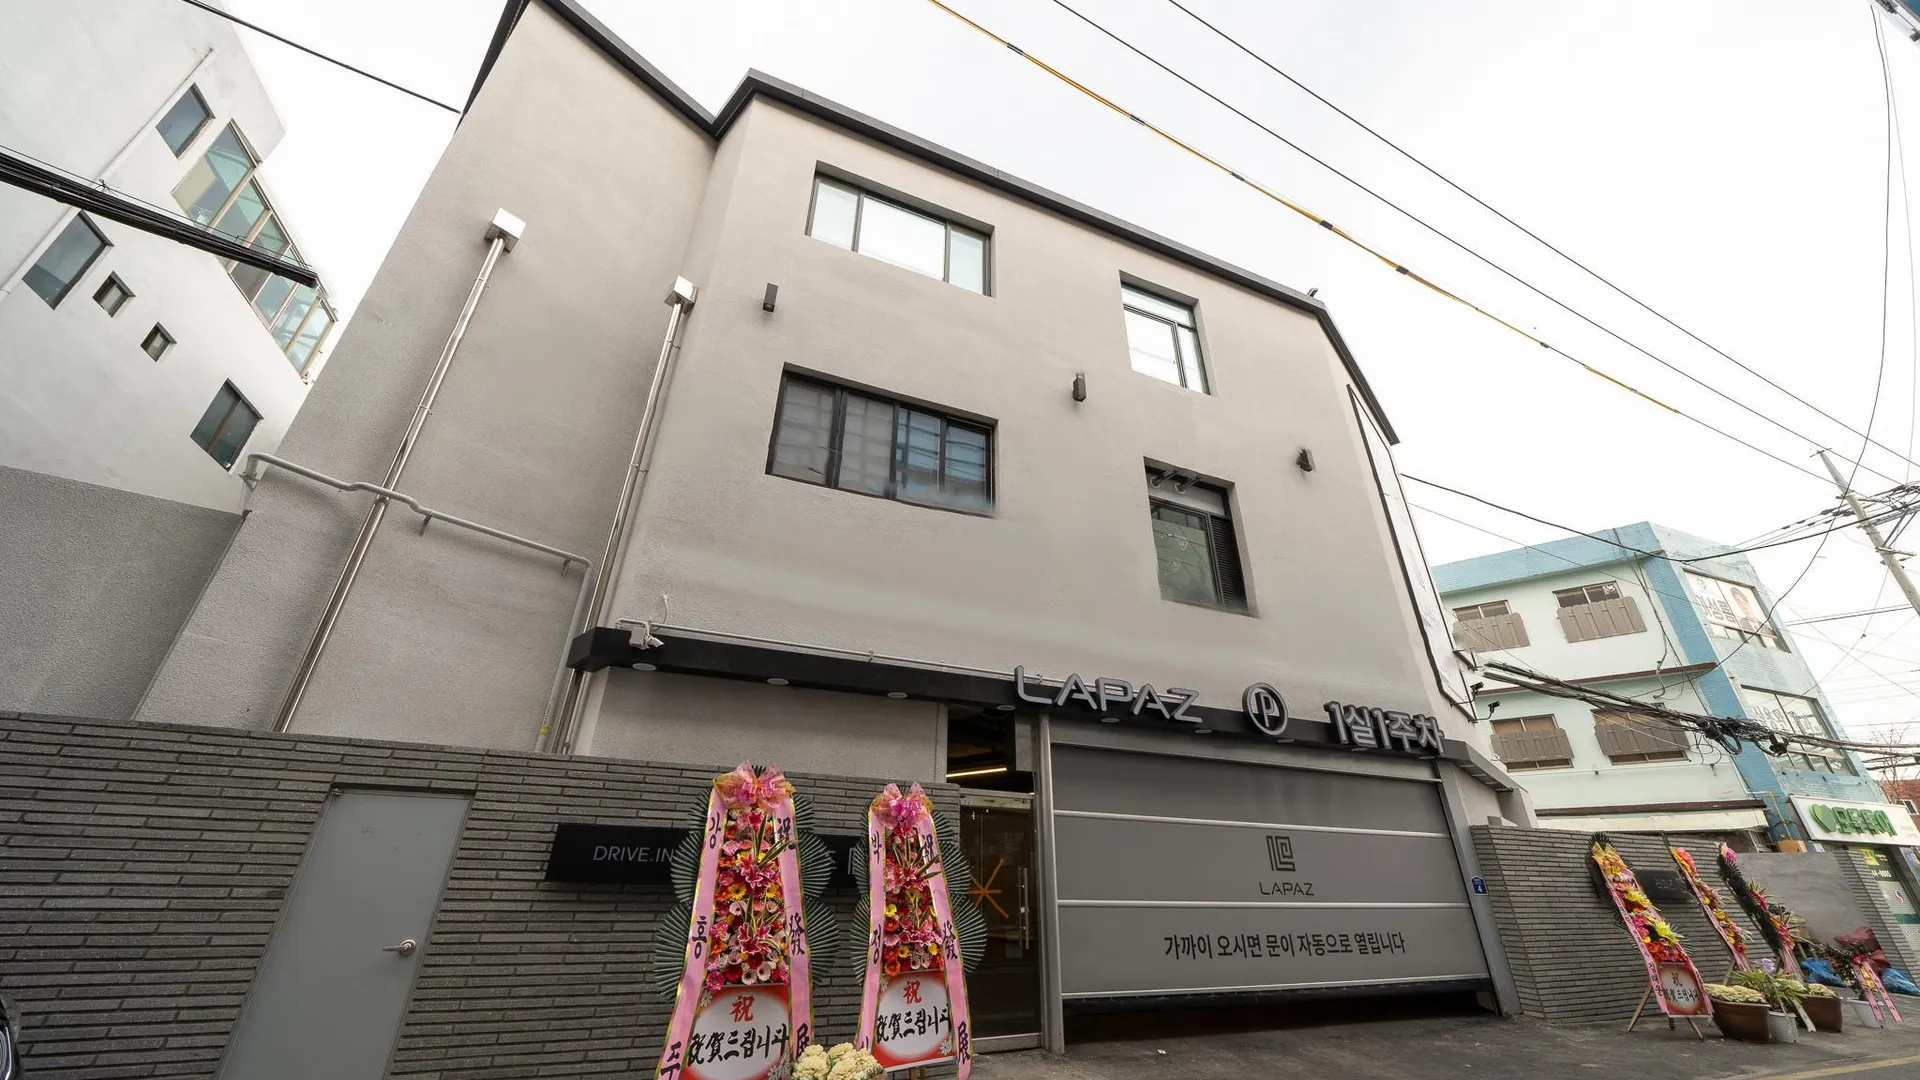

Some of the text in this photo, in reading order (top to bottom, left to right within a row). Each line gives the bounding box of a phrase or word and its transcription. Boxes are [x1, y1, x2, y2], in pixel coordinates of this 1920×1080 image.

[1014, 664, 1203, 723] LAPAZ
[1323, 700, 1446, 756] 1실1주차
[1258, 880, 1316, 896] LAPAZ
[1164, 931, 1406, 960] 가까이 오시면 문이 자동으로 열립니다
[903, 980, 922, 1005] 祝
[730, 995, 755, 1023] 祝
